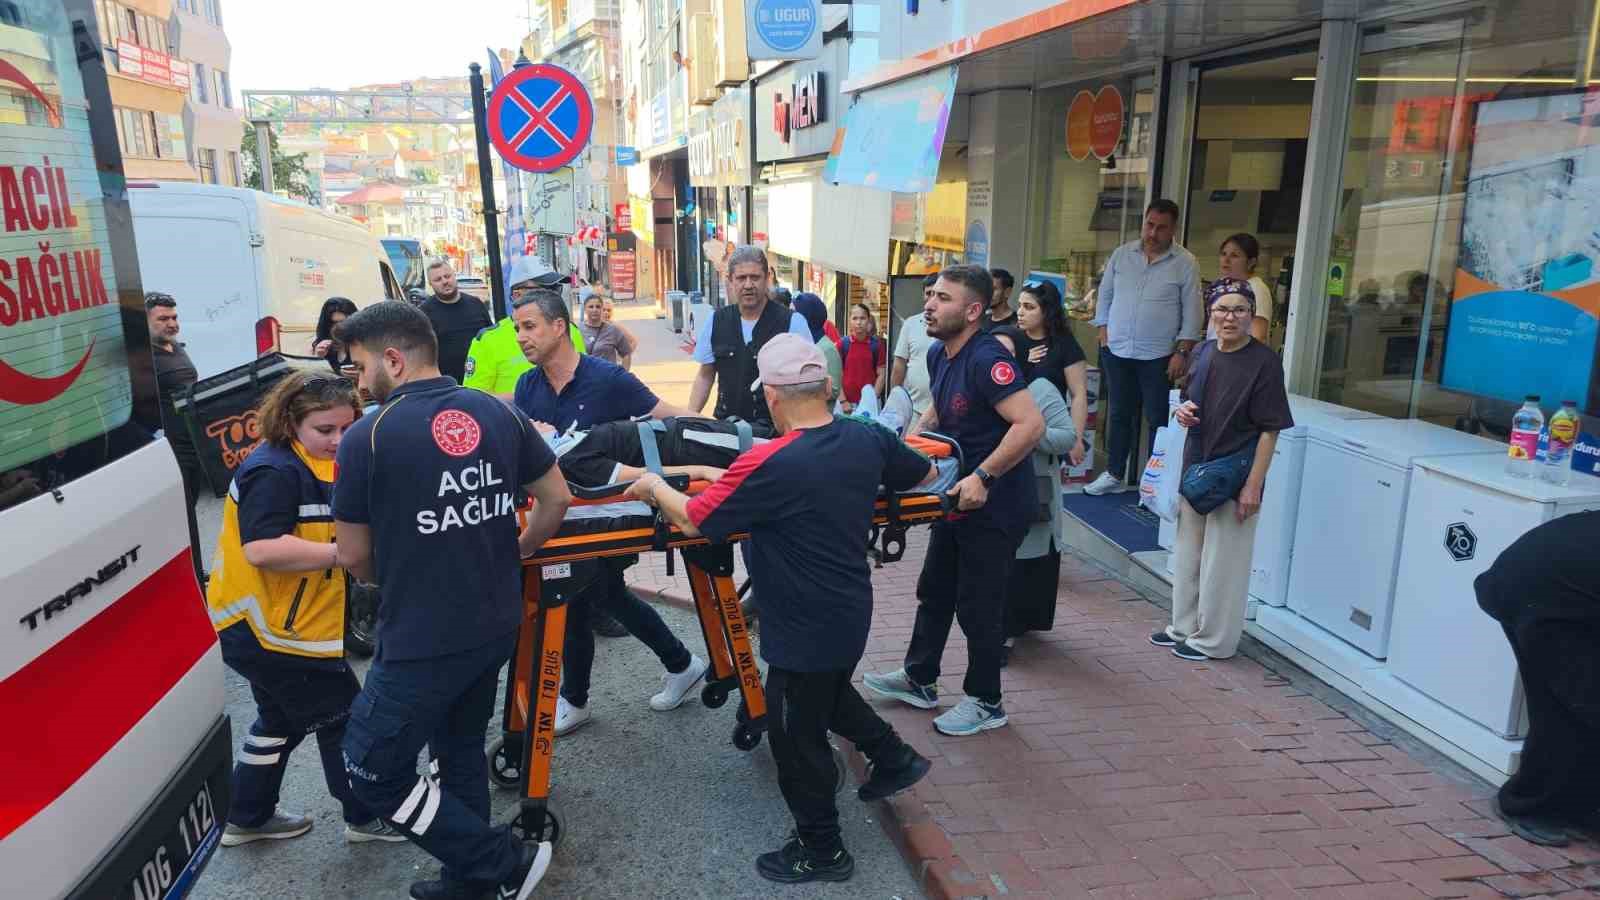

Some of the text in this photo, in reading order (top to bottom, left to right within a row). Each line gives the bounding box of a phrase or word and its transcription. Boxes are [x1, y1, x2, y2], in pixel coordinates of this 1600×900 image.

[0, 156, 78, 232] ACİL
[0, 241, 109, 327] SAĞLIK
[438, 459, 503, 497] ACİL
[416, 493, 515, 535] SAĞLIK
[19, 544, 142, 631] TRANSIT
[179, 790, 213, 856] 112
